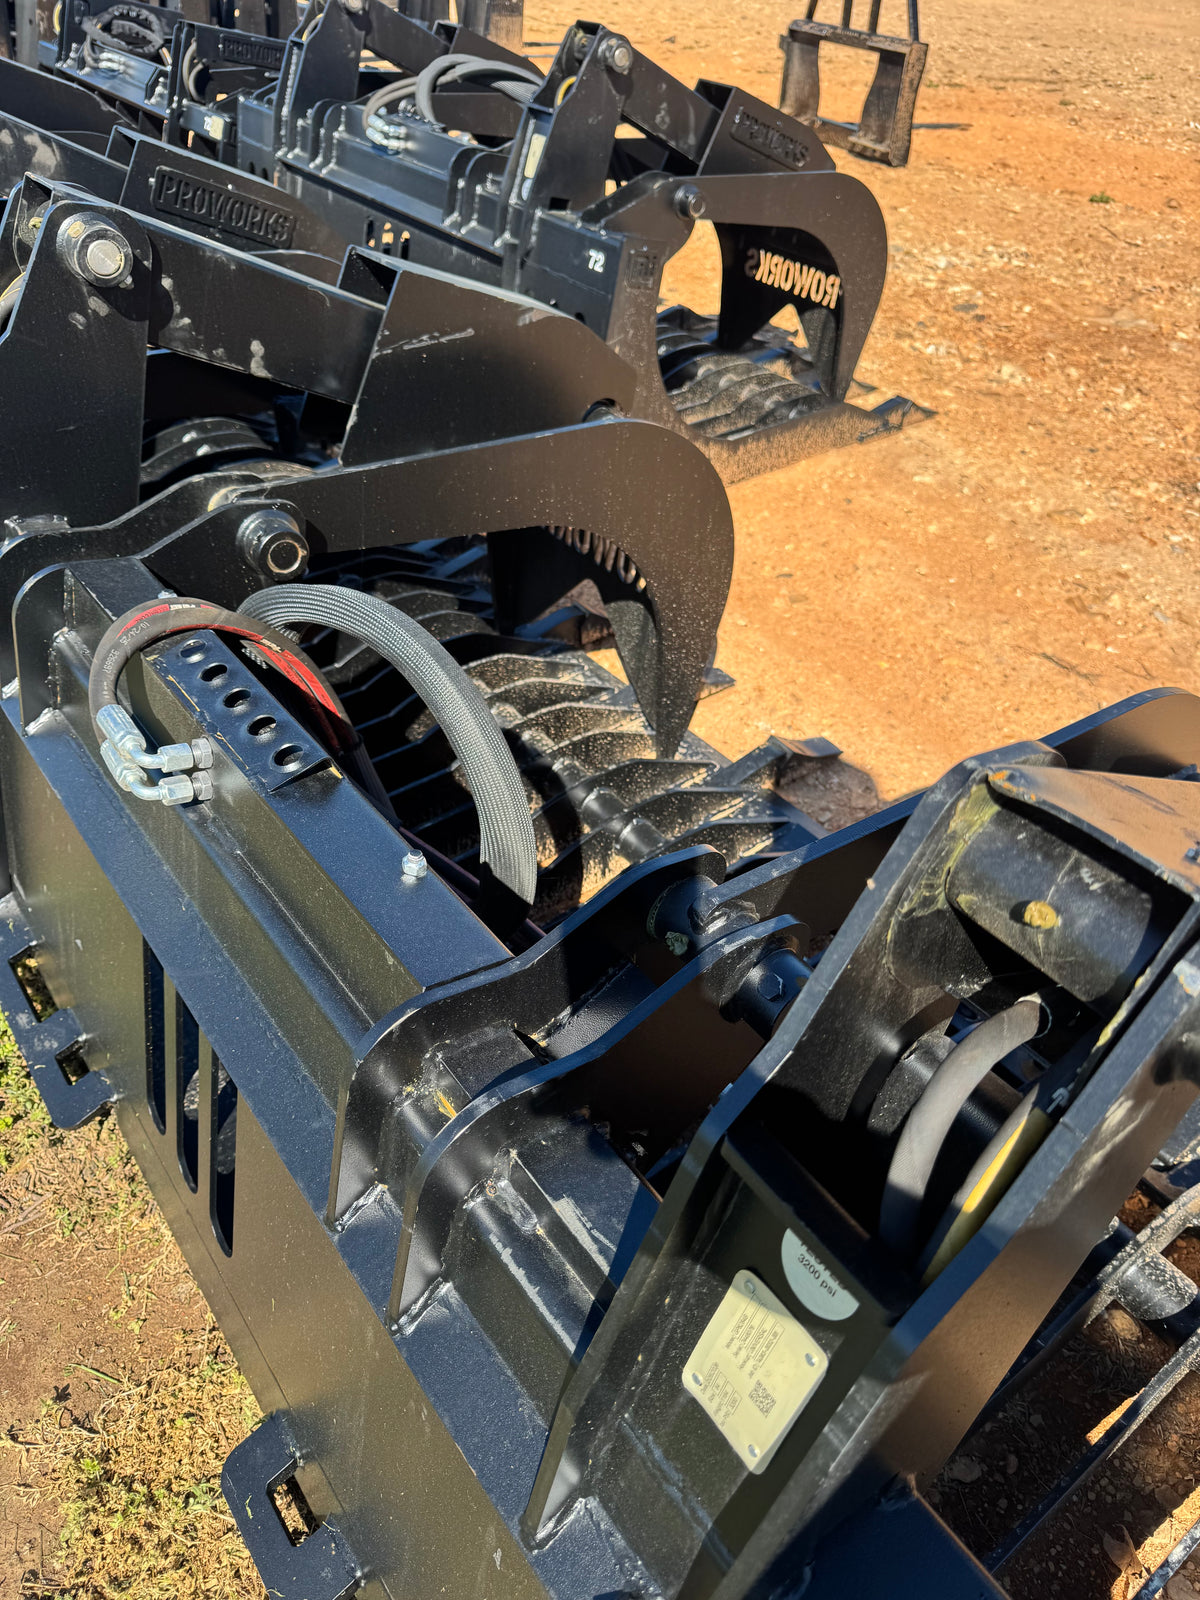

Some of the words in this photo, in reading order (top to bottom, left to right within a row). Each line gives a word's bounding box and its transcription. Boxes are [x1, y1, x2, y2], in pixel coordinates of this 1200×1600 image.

[158, 173, 290, 242] PROWORKS
[588, 248, 605, 273] 72
[798, 1253, 821, 1280] 3200
[820, 1280, 837, 1297] psi
